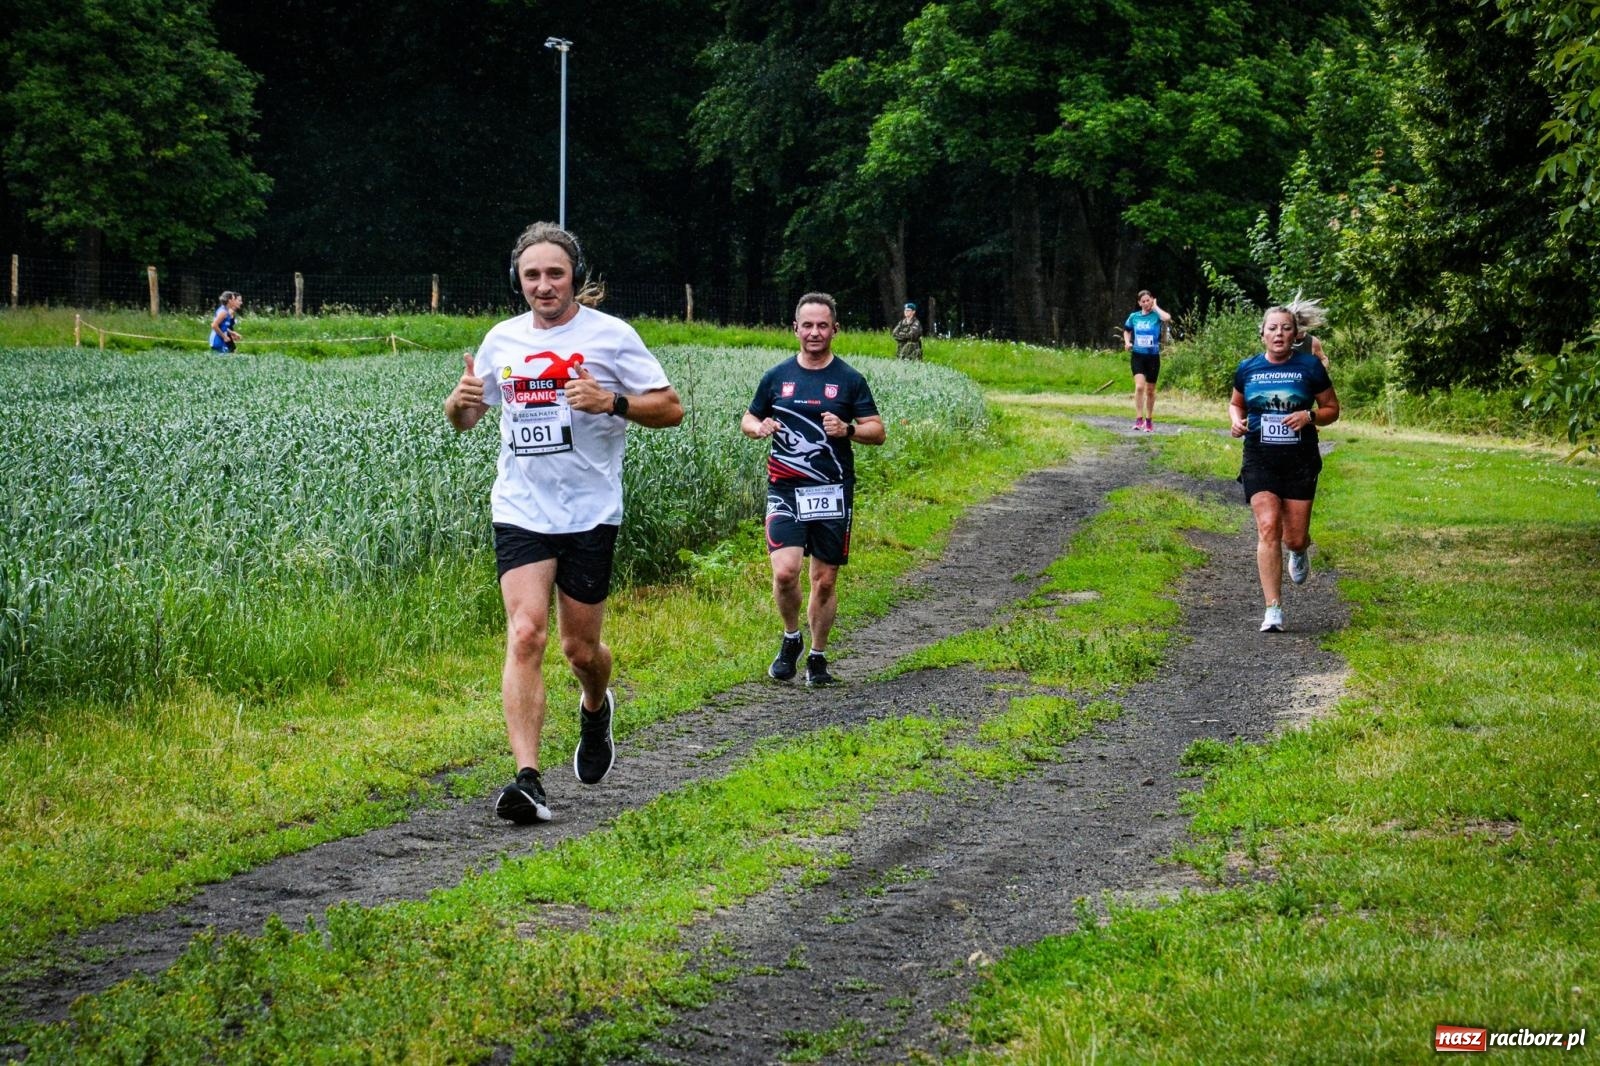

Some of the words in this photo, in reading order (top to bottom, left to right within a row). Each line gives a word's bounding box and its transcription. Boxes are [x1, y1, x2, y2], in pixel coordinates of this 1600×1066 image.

[1251, 372, 1302, 381] STACHOWNIA
[529, 380, 554, 390] BIEG
[516, 391, 556, 402] GRANIC
[521, 425, 552, 443] 061
[1269, 425, 1289, 435] 018
[806, 497, 830, 510] 178
